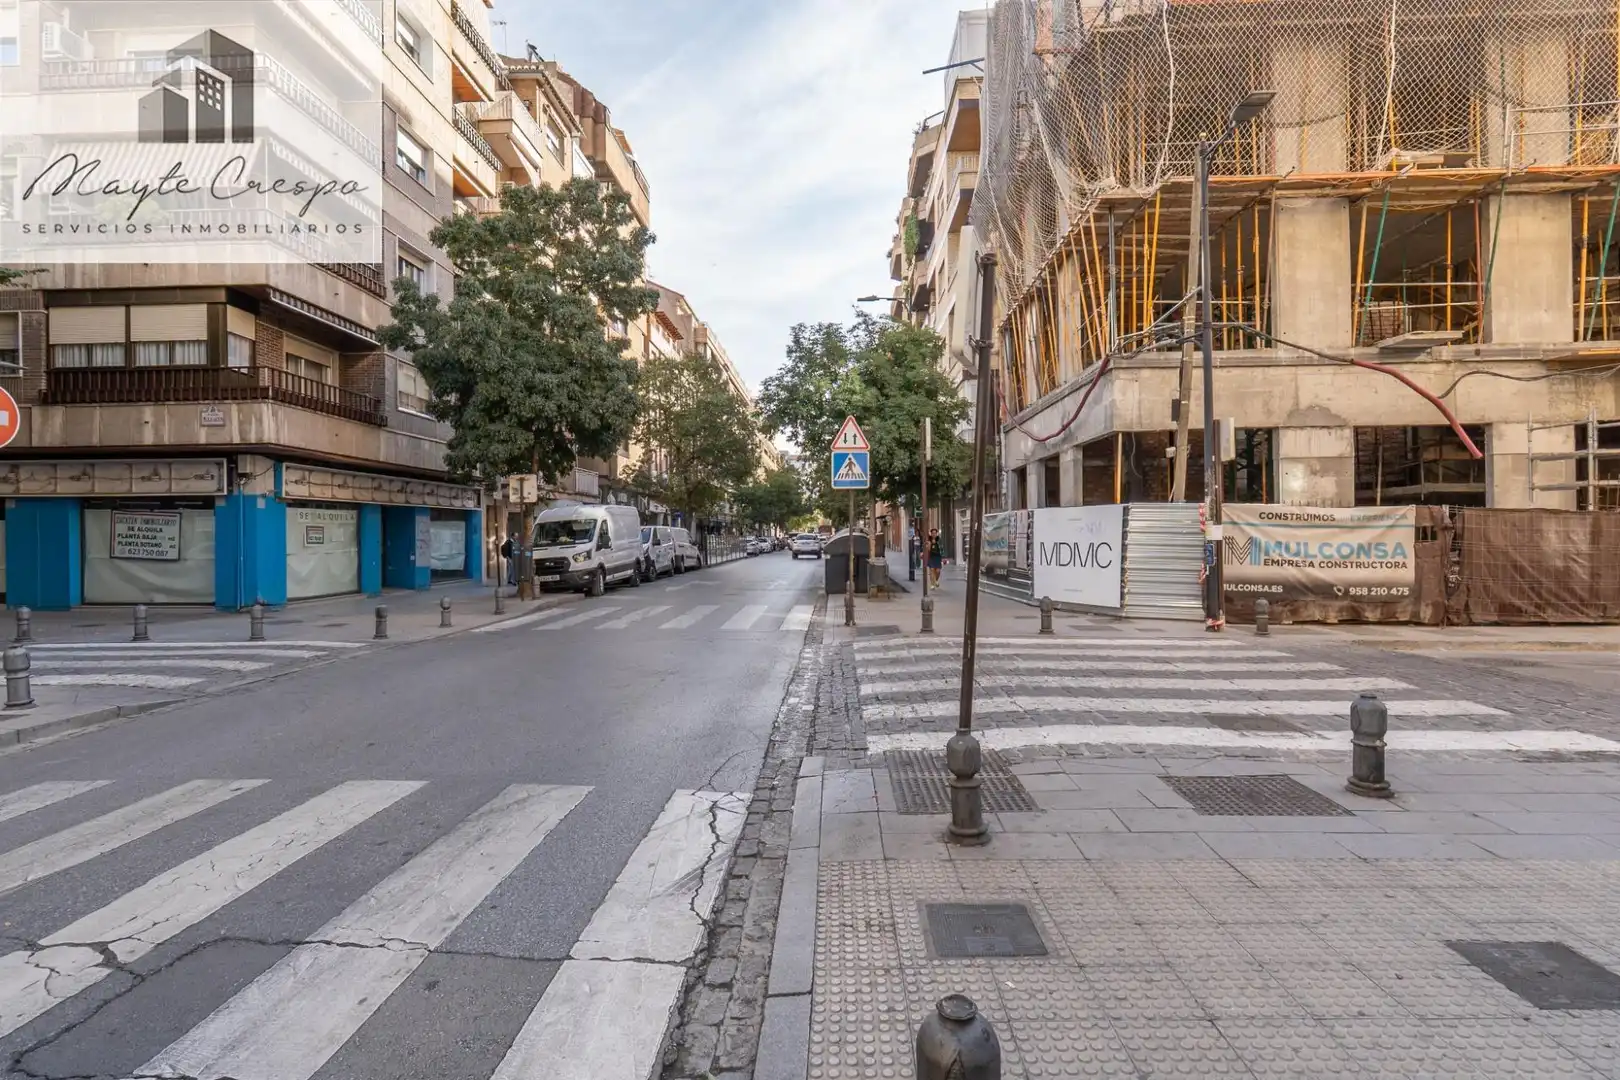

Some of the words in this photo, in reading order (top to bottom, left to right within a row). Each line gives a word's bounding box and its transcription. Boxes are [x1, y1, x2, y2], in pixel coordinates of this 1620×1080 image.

[299, 511, 309, 520] SE
[317, 512, 355, 521] ALQUILA
[1258, 511, 1336, 522] CONSTRUIMOS
[137, 526, 163, 534] ALQUILA
[117, 540, 139, 548] PLANTA
[127, 548, 140, 556] 623
[142, 549, 155, 557] 750
[1039, 541, 1113, 569] MDMC
[1264, 541, 1408, 559] MULCONSA
[1263, 558, 1316, 569] EMPRESA
[1319, 560, 1408, 570] CONSTRUCTORA
[1349, 586, 1368, 596] 958
[1370, 586, 1388, 596] 210
[1390, 586, 1409, 596] 475
